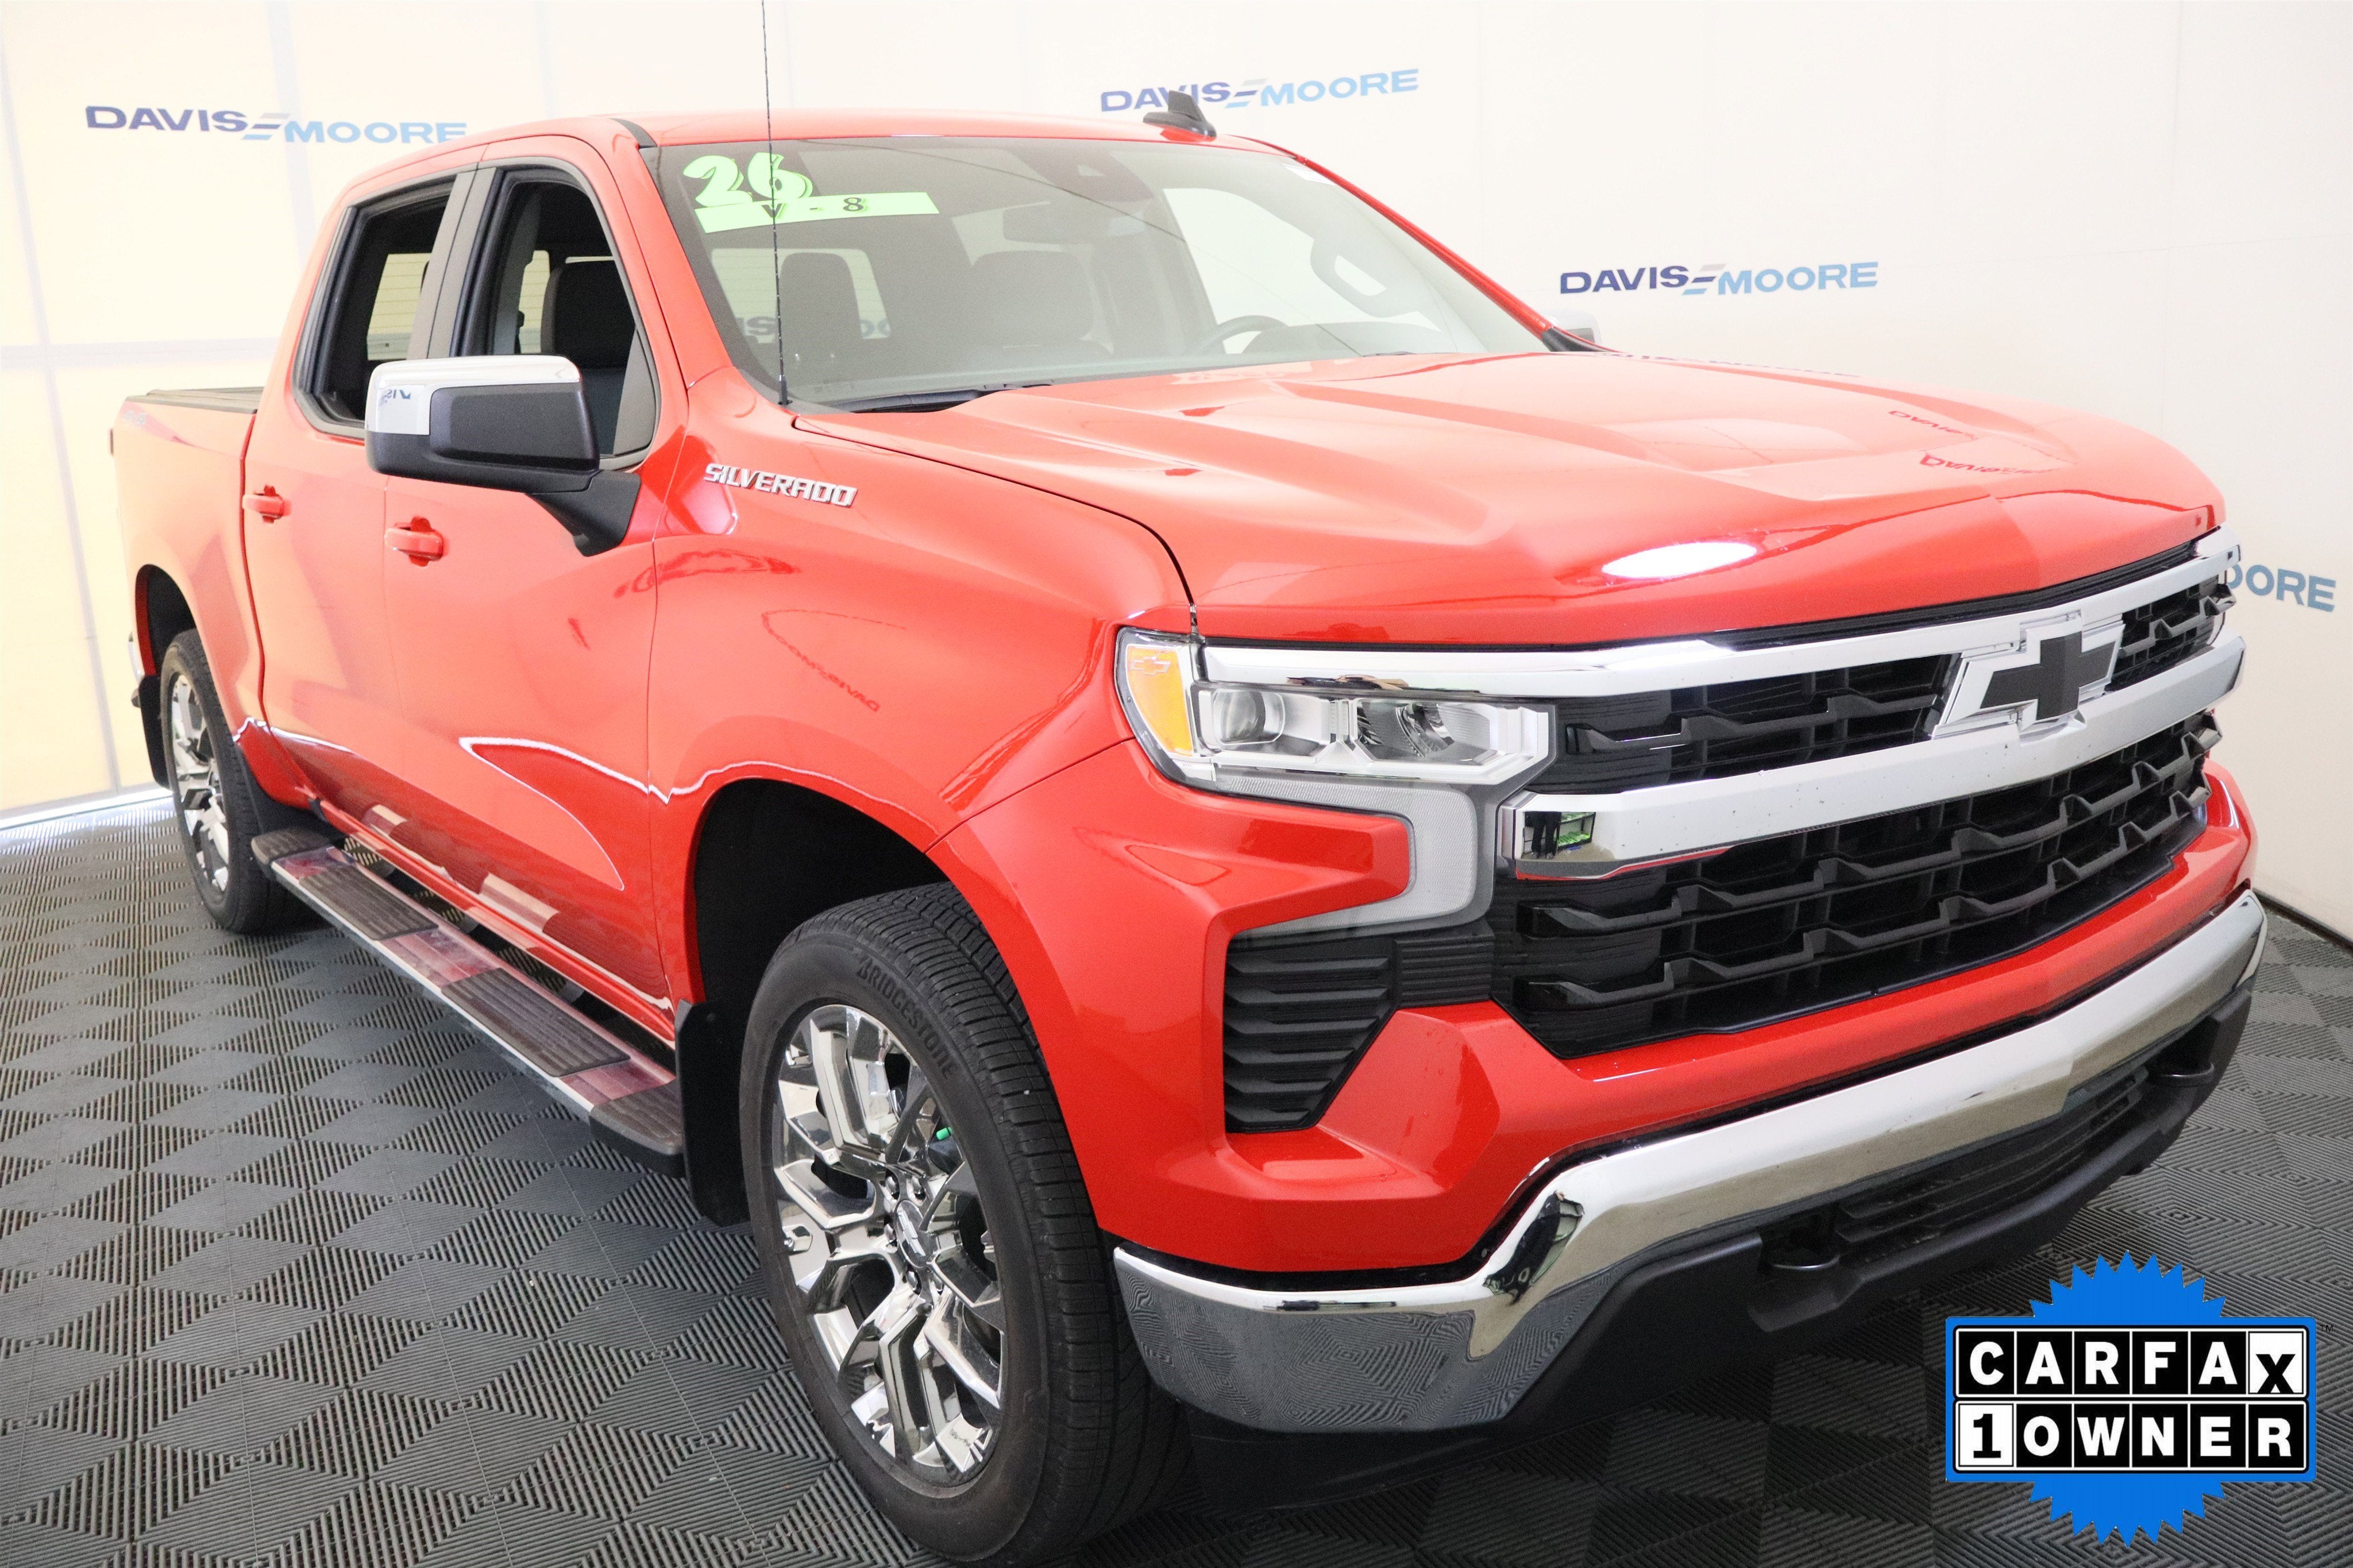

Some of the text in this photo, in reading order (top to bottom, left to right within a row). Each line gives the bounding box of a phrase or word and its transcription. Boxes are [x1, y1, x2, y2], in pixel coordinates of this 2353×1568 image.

[1261, 68, 1419, 106] MOORE
[85, 106, 466, 143] DAVIS MOORE
[683, 152, 813, 207] 26
[1560, 261, 1878, 295] DAVIS MOORE
[704, 463, 858, 508] SILVERADO
[2225, 563, 2336, 612] OORE
[857, 955, 952, 1080] BRIDGESTONE
